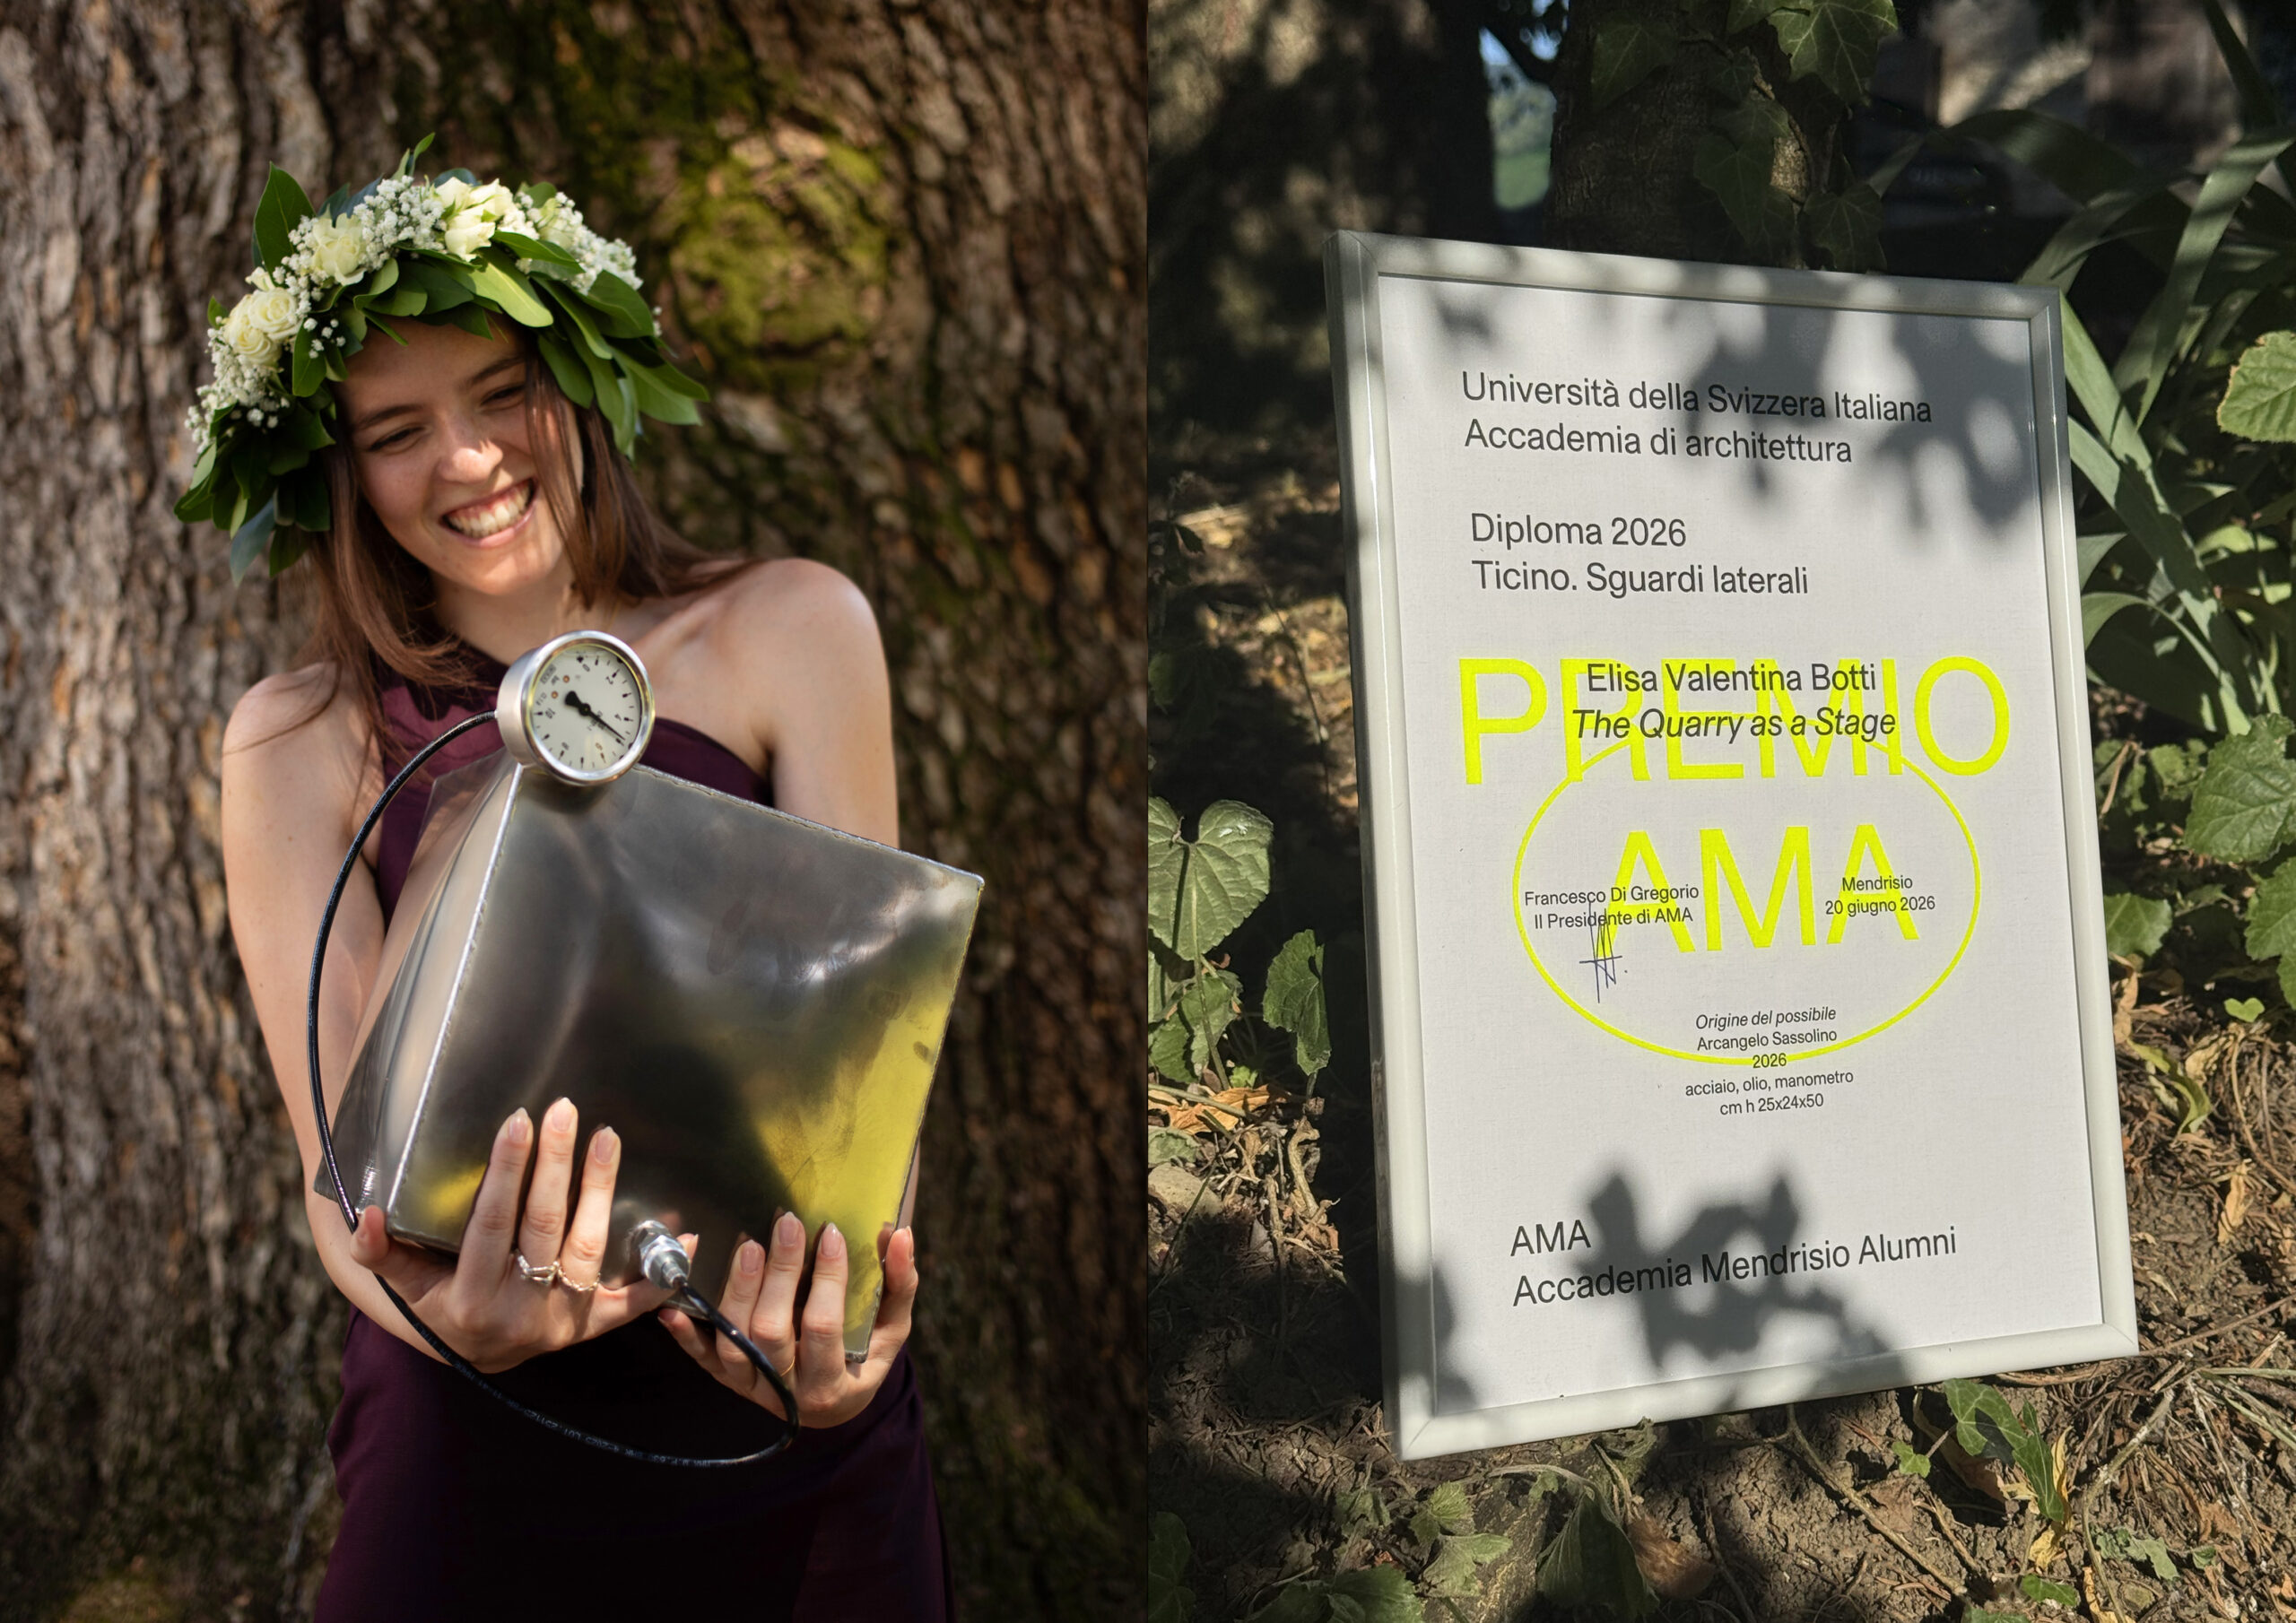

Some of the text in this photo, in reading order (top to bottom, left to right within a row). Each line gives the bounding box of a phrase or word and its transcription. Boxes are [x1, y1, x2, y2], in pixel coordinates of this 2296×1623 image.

[1463, 371, 1930, 421] Università della Svizzera Italiana
[1465, 419, 1851, 462] Accademia di architettura
[1472, 513, 1686, 550] Diploma 2026
[1472, 560, 1807, 598] Ticino. Sguardi laterali
[1587, 664, 1875, 691] Elisa Valentina Botti
[1459, 655, 2010, 785] PREMIO
[1573, 707, 1895, 744] The Quarry as a Stage
[1526, 884, 1699, 907] Francesco Di Gregorio
[1596, 824, 1919, 959] AMA
[1842, 875, 1912, 891] Mendrisio
[1535, 907, 1693, 930] Il Presidente di AMA
[1825, 896, 1935, 917] 20 giugno 2026
[1696, 1007, 1836, 1031] Origine del possibile
[1698, 1028, 1837, 1051] Arcangelo Sassolino
[1752, 1053, 1787, 1068] 2026
[1686, 1071, 1853, 1096] acciaio, olio, manometro
[1720, 1093, 1823, 1115] cm h 25x24x50
[1510, 1219, 1591, 1256] AMA
[1513, 1226, 1955, 1306] Accademia Mendrisio Alumni
